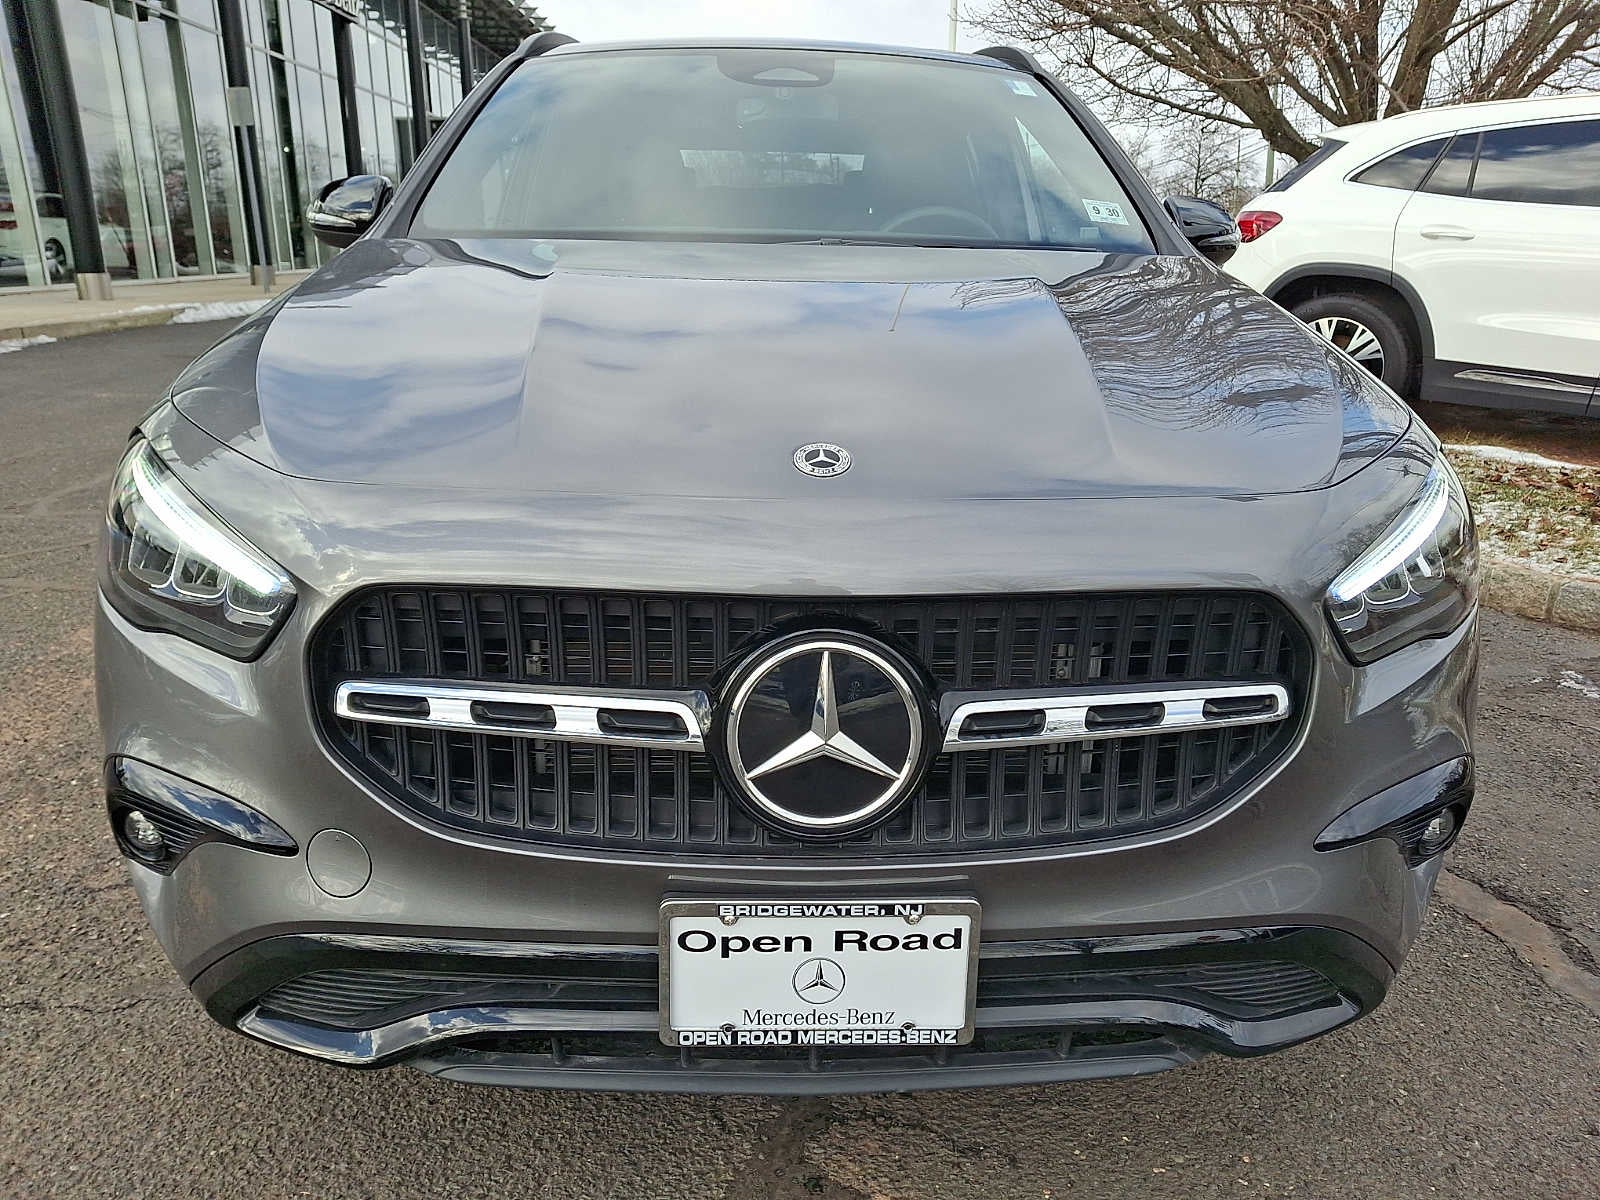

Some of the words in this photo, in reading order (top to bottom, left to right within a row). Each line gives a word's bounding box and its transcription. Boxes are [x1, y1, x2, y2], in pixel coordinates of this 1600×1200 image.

[1092, 205, 1101, 215] 9
[1105, 207, 1120, 218] 30
[719, 904, 886, 917] BRIDGEWATER,
[894, 904, 923, 916] NJ
[677, 929, 812, 958] Open
[834, 927, 963, 952] Road
[742, 1008, 895, 1026] Mercedes-Benz
[679, 1031, 732, 1045] OPEN
[737, 1031, 793, 1045] ROAD
